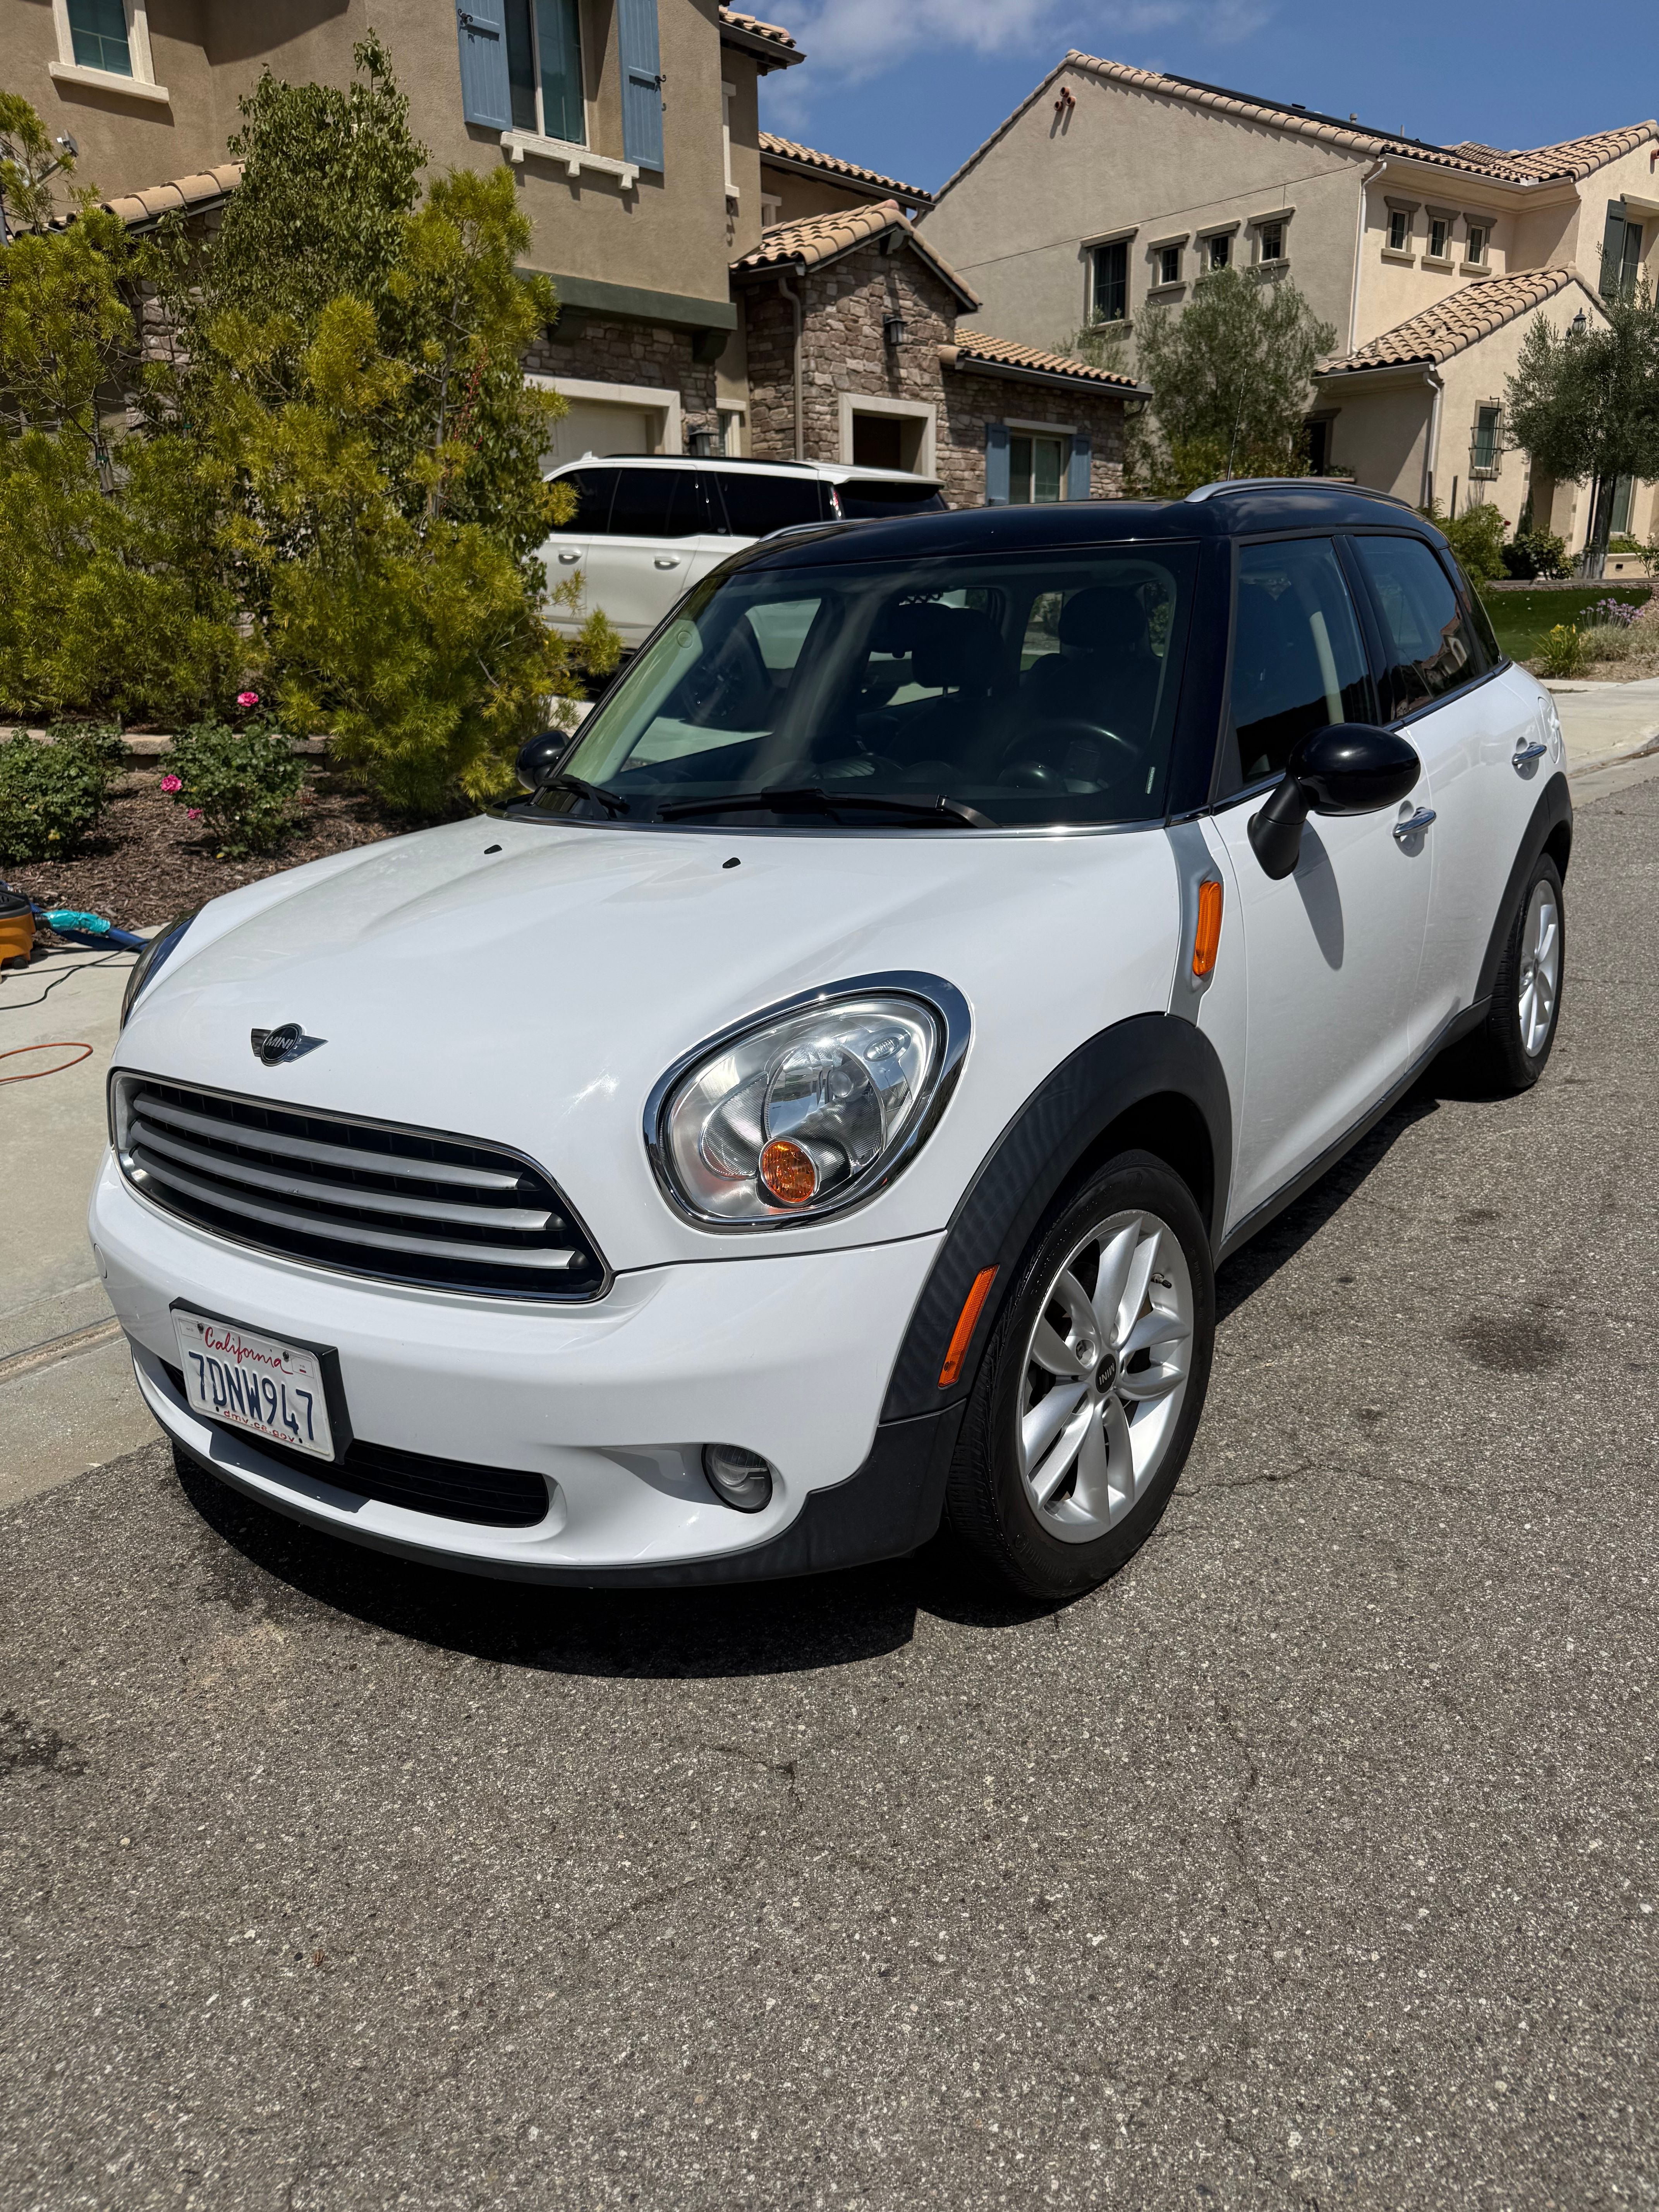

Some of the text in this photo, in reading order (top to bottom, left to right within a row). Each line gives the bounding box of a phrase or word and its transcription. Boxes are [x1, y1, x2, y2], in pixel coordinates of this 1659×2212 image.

[266, 1036, 294, 1049] MINI
[205, 1326, 294, 1375] California
[1099, 1363, 1115, 1385] MINI
[189, 1351, 314, 1441] 7DNW947
[224, 1410, 295, 1442] dmv.ca.gov
